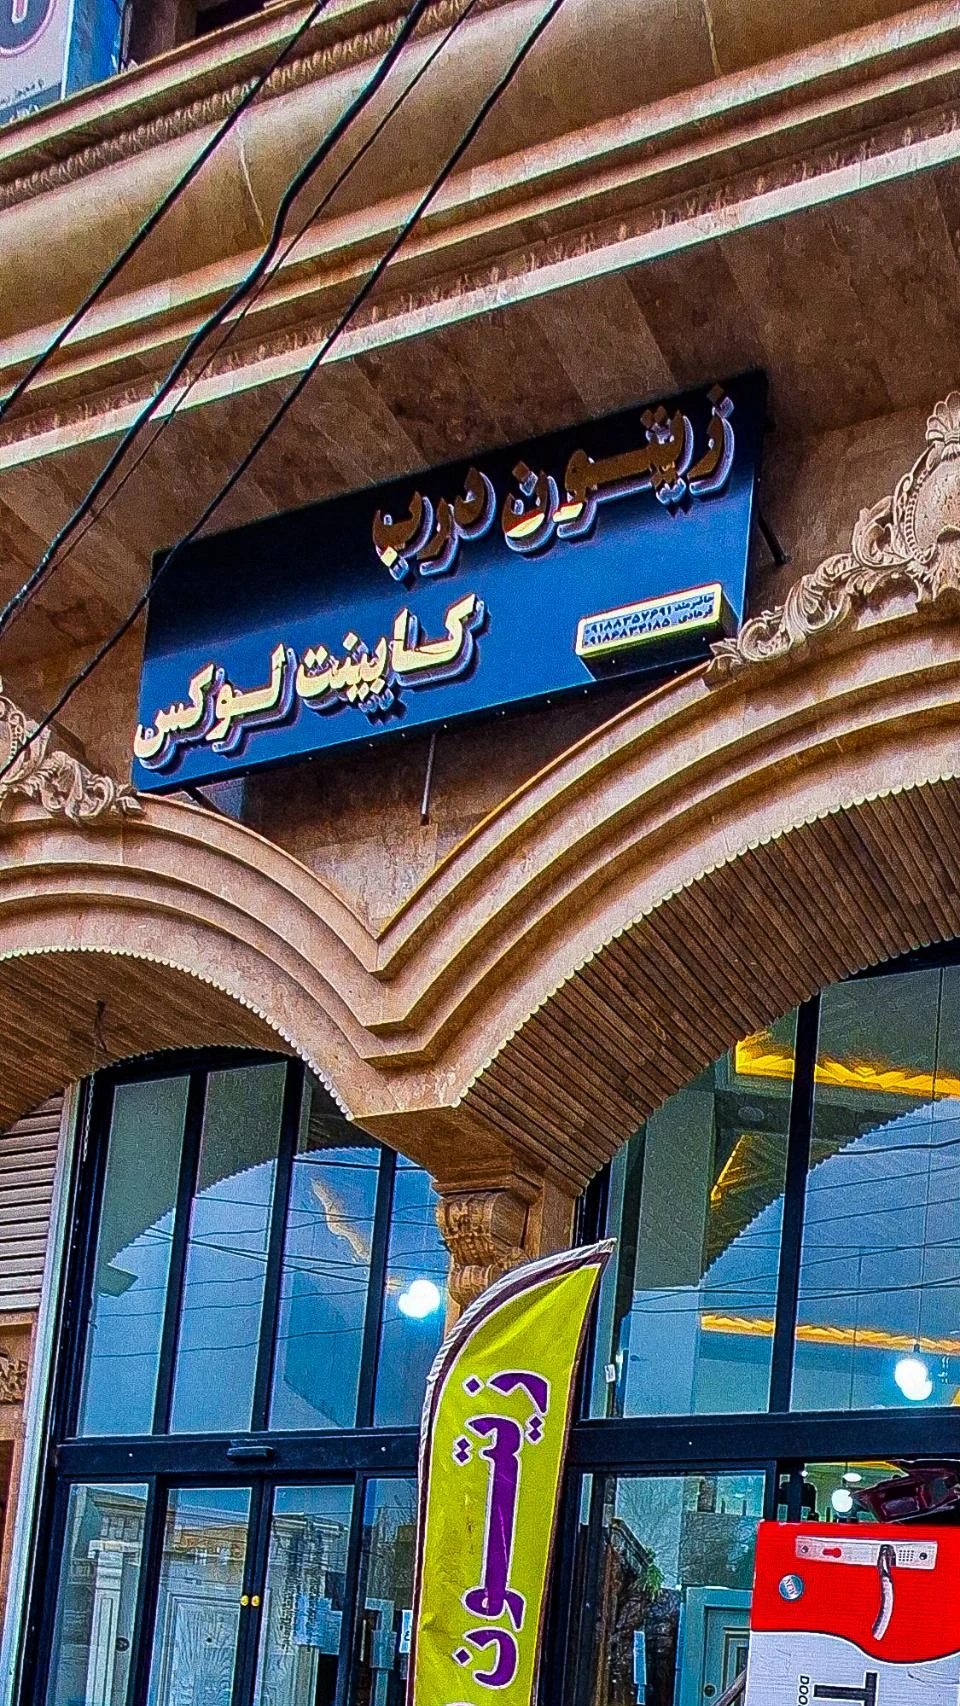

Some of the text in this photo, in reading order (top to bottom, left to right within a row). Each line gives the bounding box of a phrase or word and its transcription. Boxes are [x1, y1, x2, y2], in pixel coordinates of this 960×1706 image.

[371, 384, 737, 582] زیتون درب
[132, 592, 486, 771] کابینت لوکس
